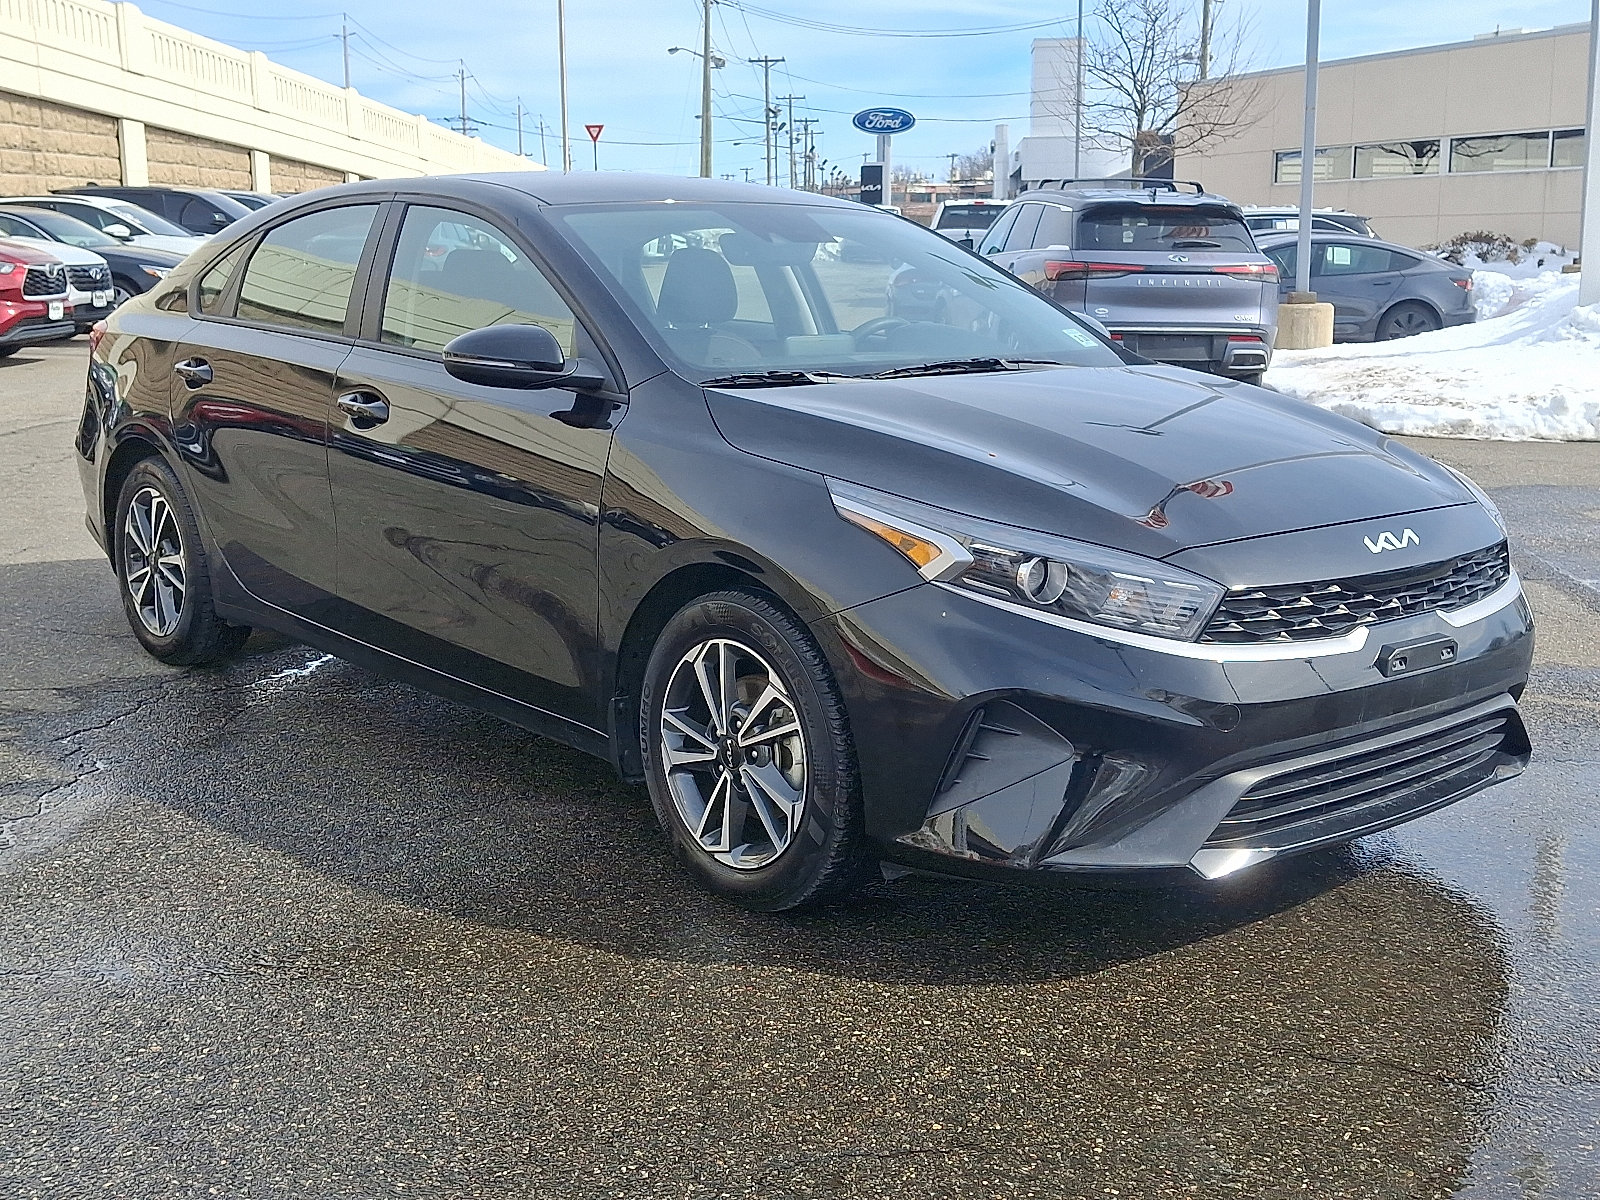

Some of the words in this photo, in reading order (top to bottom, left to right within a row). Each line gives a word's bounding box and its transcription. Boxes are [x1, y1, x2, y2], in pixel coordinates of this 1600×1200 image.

[865, 112, 903, 128] Ford
[1137, 279, 1221, 287] INFINITI
[1363, 528, 1420, 554] KIA
[640, 682, 652, 771] KUMHO
